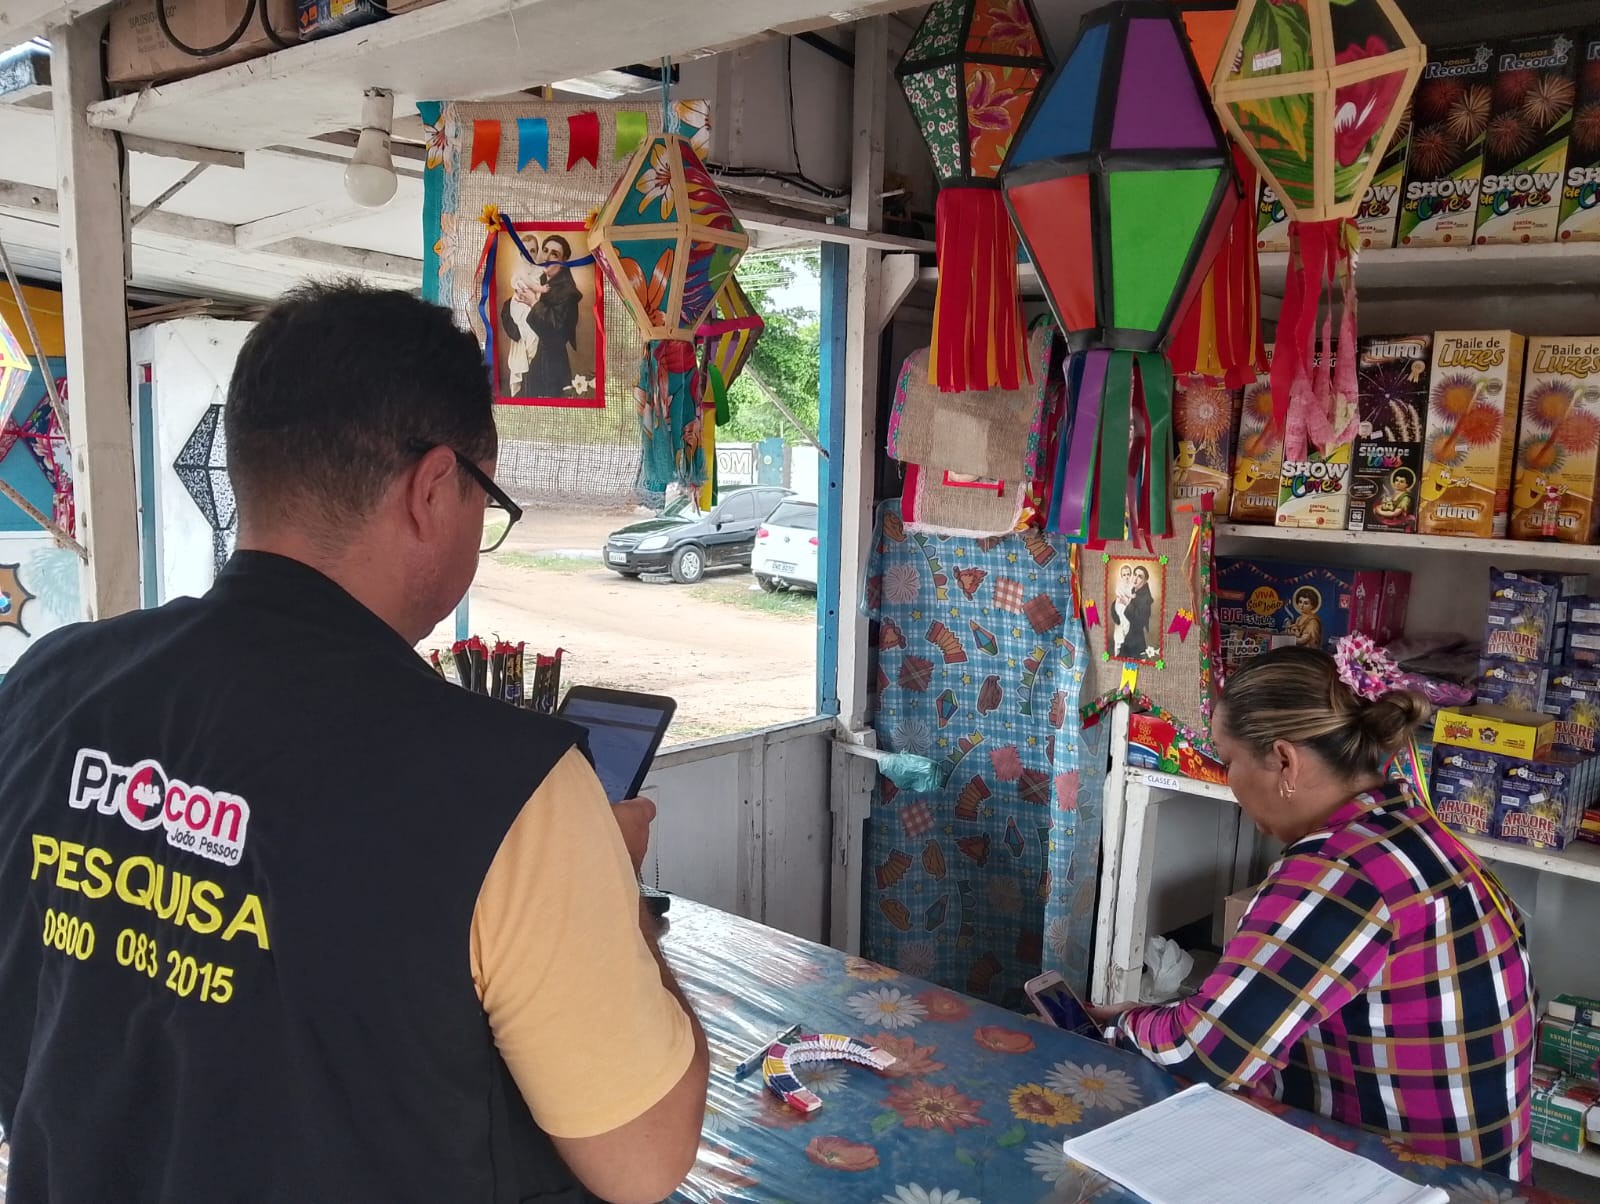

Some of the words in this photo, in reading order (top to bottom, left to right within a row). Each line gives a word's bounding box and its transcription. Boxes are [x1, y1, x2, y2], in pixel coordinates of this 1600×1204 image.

[1425, 62, 1489, 79] Recorde
[1498, 53, 1569, 72] Recorde
[1406, 179, 1479, 200] SHOW
[1481, 172, 1559, 195] SHOW
[1565, 187, 1580, 199] de
[1405, 200, 1418, 212] de
[1417, 194, 1472, 220] Cores
[1480, 194, 1494, 205] de
[1493, 188, 1552, 216] Cores
[1455, 337, 1483, 349] Baile
[1486, 336, 1501, 348] de
[1552, 343, 1582, 355] Baile
[1584, 343, 1600, 355] de
[1438, 343, 1506, 371] Luzes
[1359, 446, 1397, 457] SHOW
[1397, 448, 1410, 457] DE
[1282, 461, 1349, 480] SHOW
[1292, 474, 1343, 499] Cores
[1436, 506, 1480, 521] OURO
[1247, 600, 1262, 610] São
[1263, 600, 1283, 612] João
[1254, 591, 1275, 600] VIVA
[1221, 607, 1243, 623] BIG
[1488, 628, 1538, 648] ÁRVORE
[1487, 643, 1503, 654] DE
[1503, 643, 1539, 660] NATAL
[1554, 720, 1595, 741] RVORE
[1147, 775, 1171, 786] CLASSE
[1171, 778, 1178, 786] A
[74, 755, 242, 843] Procon
[1437, 797, 1488, 819] ÁRVORE
[1436, 812, 1452, 823] DE
[1452, 813, 1488, 833] NATAL
[1502, 810, 1556, 834] ÁRVORE
[170, 829, 196, 847] João
[198, 837, 239, 861] Pessoa
[1501, 825, 1518, 837] DE
[1518, 825, 1557, 847] NATAL
[31, 833, 270, 951] PESQUISA
[43, 908, 95, 961] 0800
[116, 928, 158, 979] 083
[165, 949, 235, 1004] 2015
